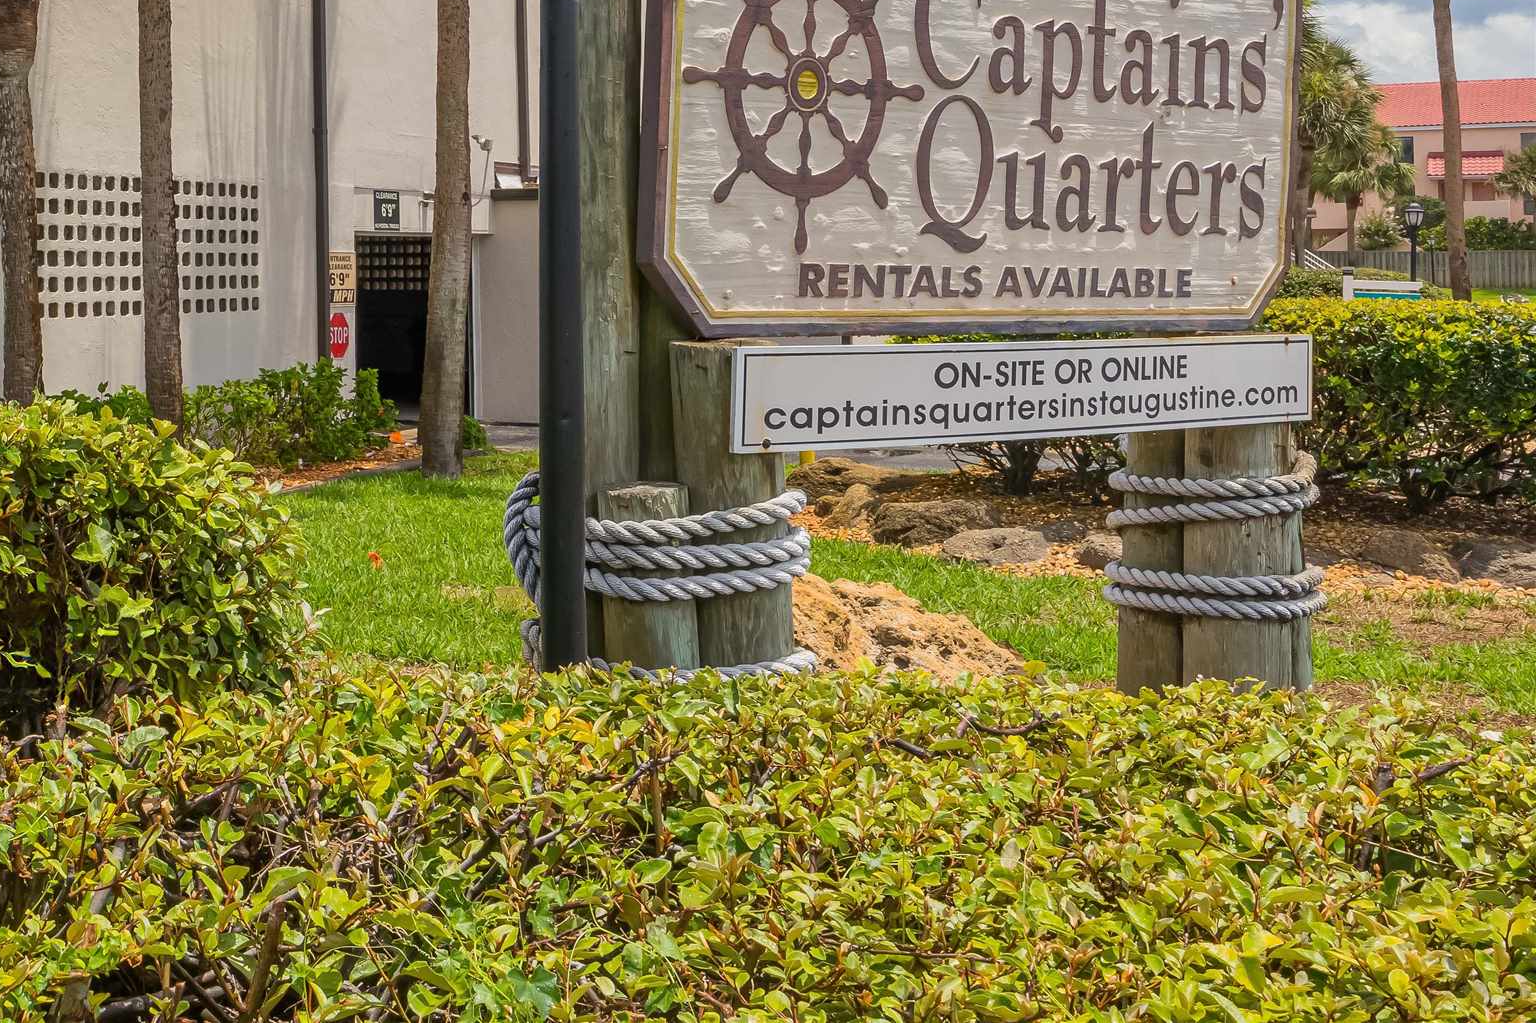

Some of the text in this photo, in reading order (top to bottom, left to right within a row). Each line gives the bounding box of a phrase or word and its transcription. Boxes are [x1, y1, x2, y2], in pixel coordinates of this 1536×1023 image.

[916, 93, 1266, 254] Quarters
[329, 255, 352, 263] NTRANCE
[329, 263, 353, 271] LEARANCE
[797, 262, 1193, 299] RENTALS AVAILABLE
[333, 289, 354, 303] MPH
[329, 326, 348, 344] STOP
[934, 354, 1188, 389] ON-SITE OR ONLINE
[763, 384, 1299, 435] captainsquartersinstaugustine.com
